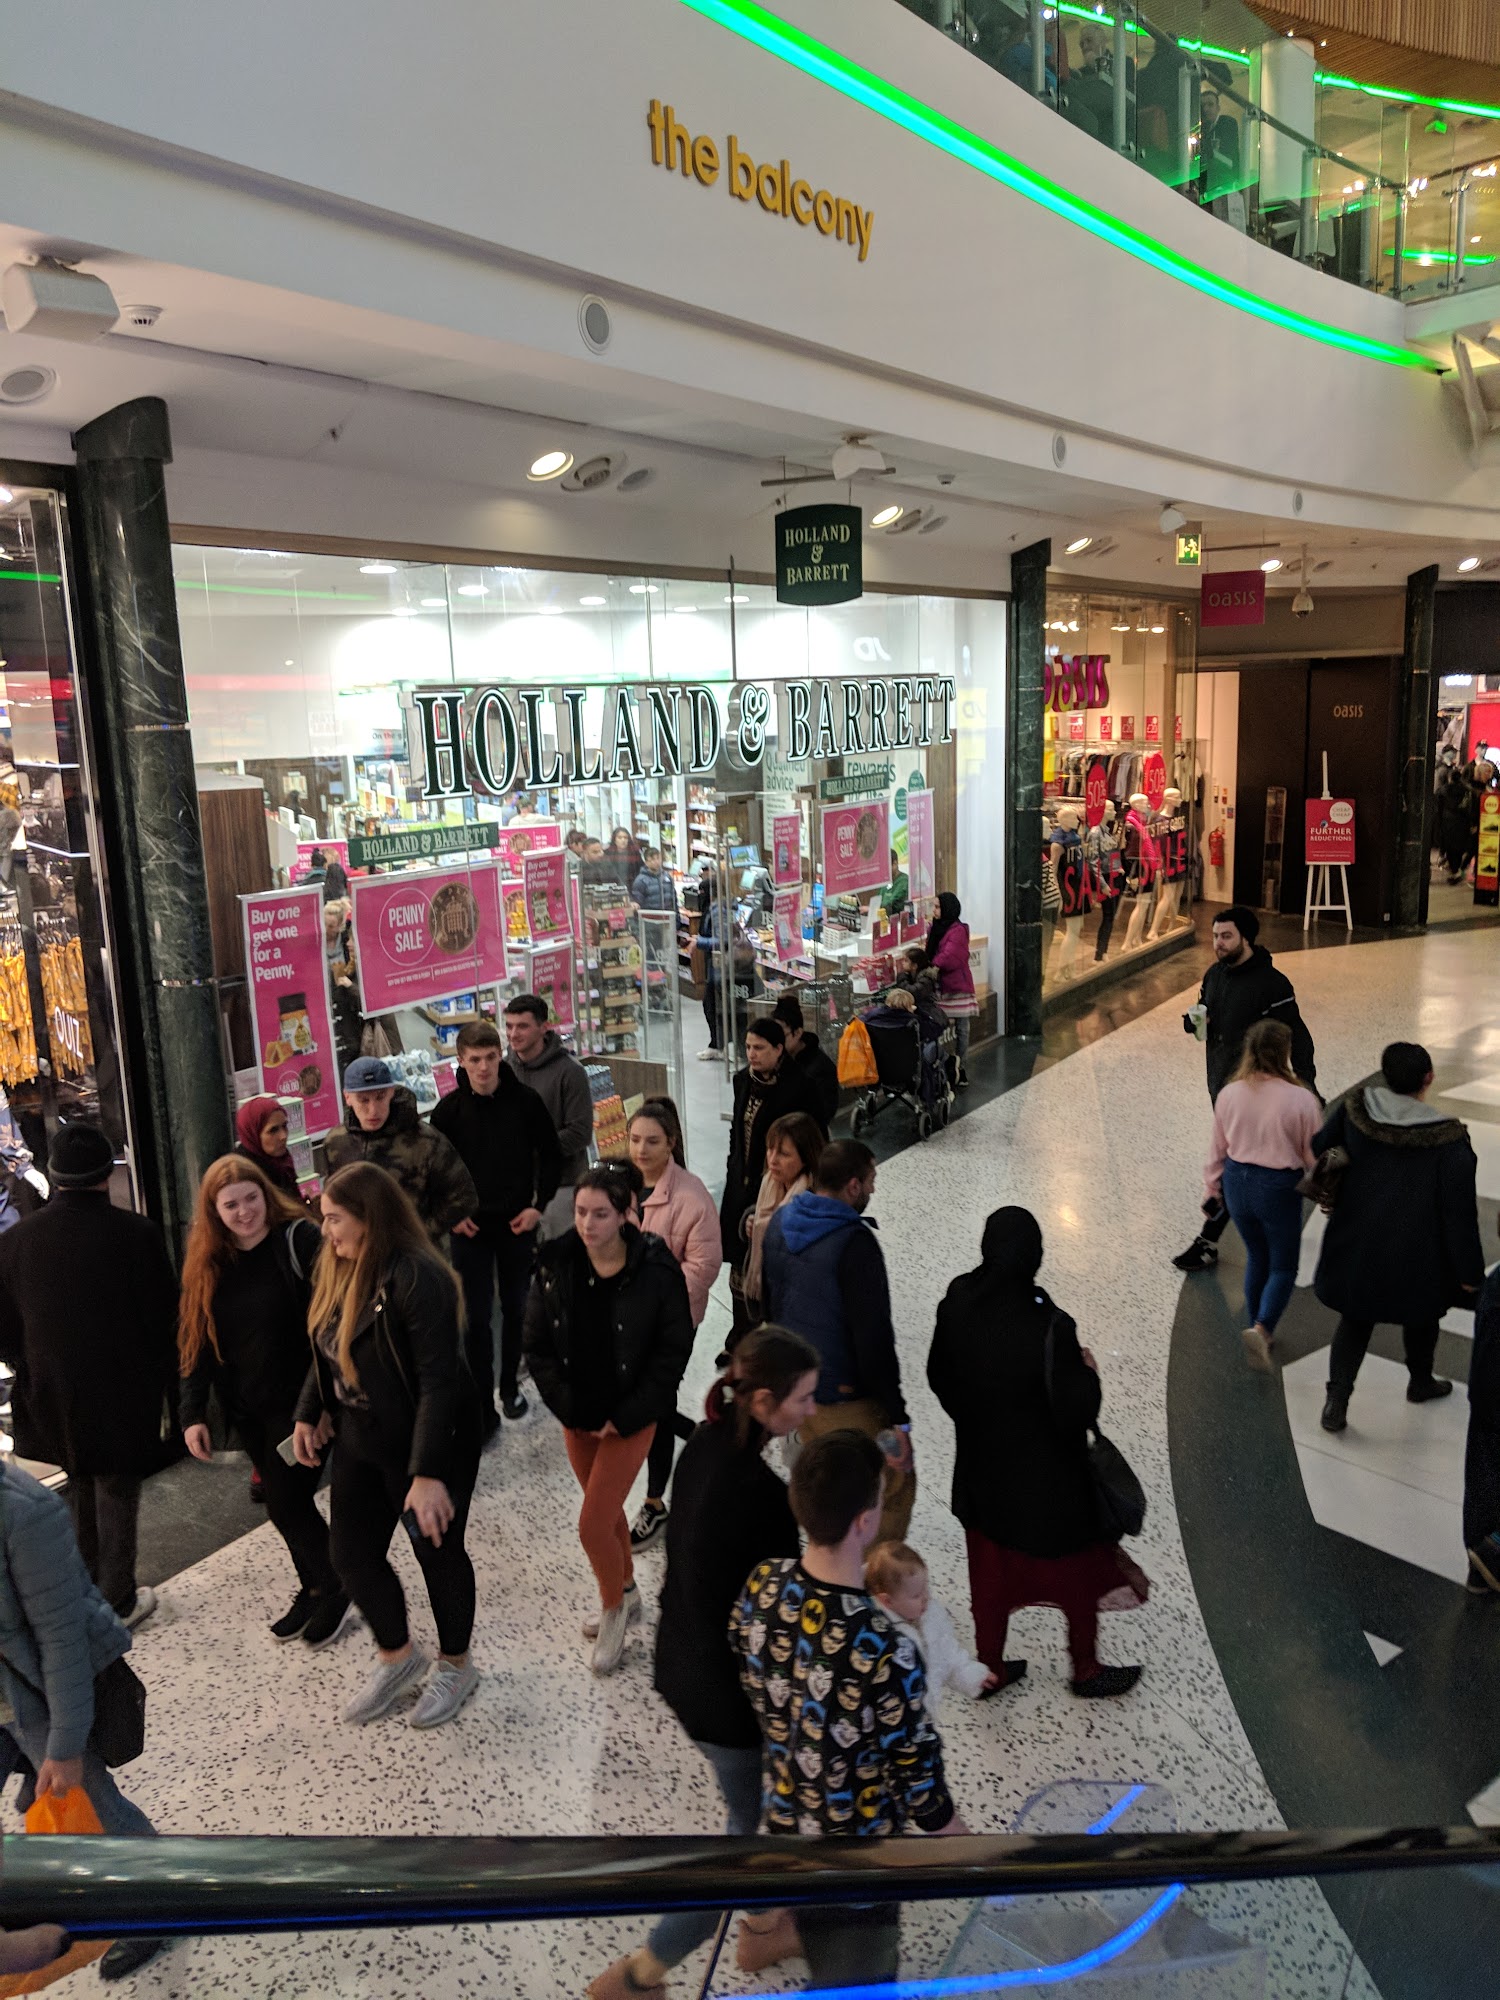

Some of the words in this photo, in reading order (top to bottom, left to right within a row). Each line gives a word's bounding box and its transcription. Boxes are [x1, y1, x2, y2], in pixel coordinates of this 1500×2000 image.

[647, 99, 720, 185] the
[727, 135, 874, 262] balcony
[785, 524, 851, 547] HOLLAND
[811, 543, 824, 564] &
[786, 563, 850, 586] BARRETT
[1209, 591, 1256, 607] oasis
[1333, 705, 1363, 718] oasis
[413, 684, 721, 800] HOLLAND
[738, 684, 771, 766] &
[786, 676, 957, 762] BARRETT
[765, 776, 794, 791] advice
[1310, 827, 1352, 835] FURTHER
[361, 834, 420, 860] HOLLAND
[421, 834, 432, 853] &
[433, 826, 489, 849] BARRETT
[251, 908, 275, 926] Buy
[277, 906, 300, 920] one
[388, 903, 425, 928] PENNY
[253, 927, 273, 947] get
[275, 925, 298, 940] one
[395, 929, 424, 953] SALE
[253, 947, 271, 963] for
[273, 947, 281, 960] a
[255, 963, 295, 982] Penny.
[55, 1006, 84, 1059] QUIZ
